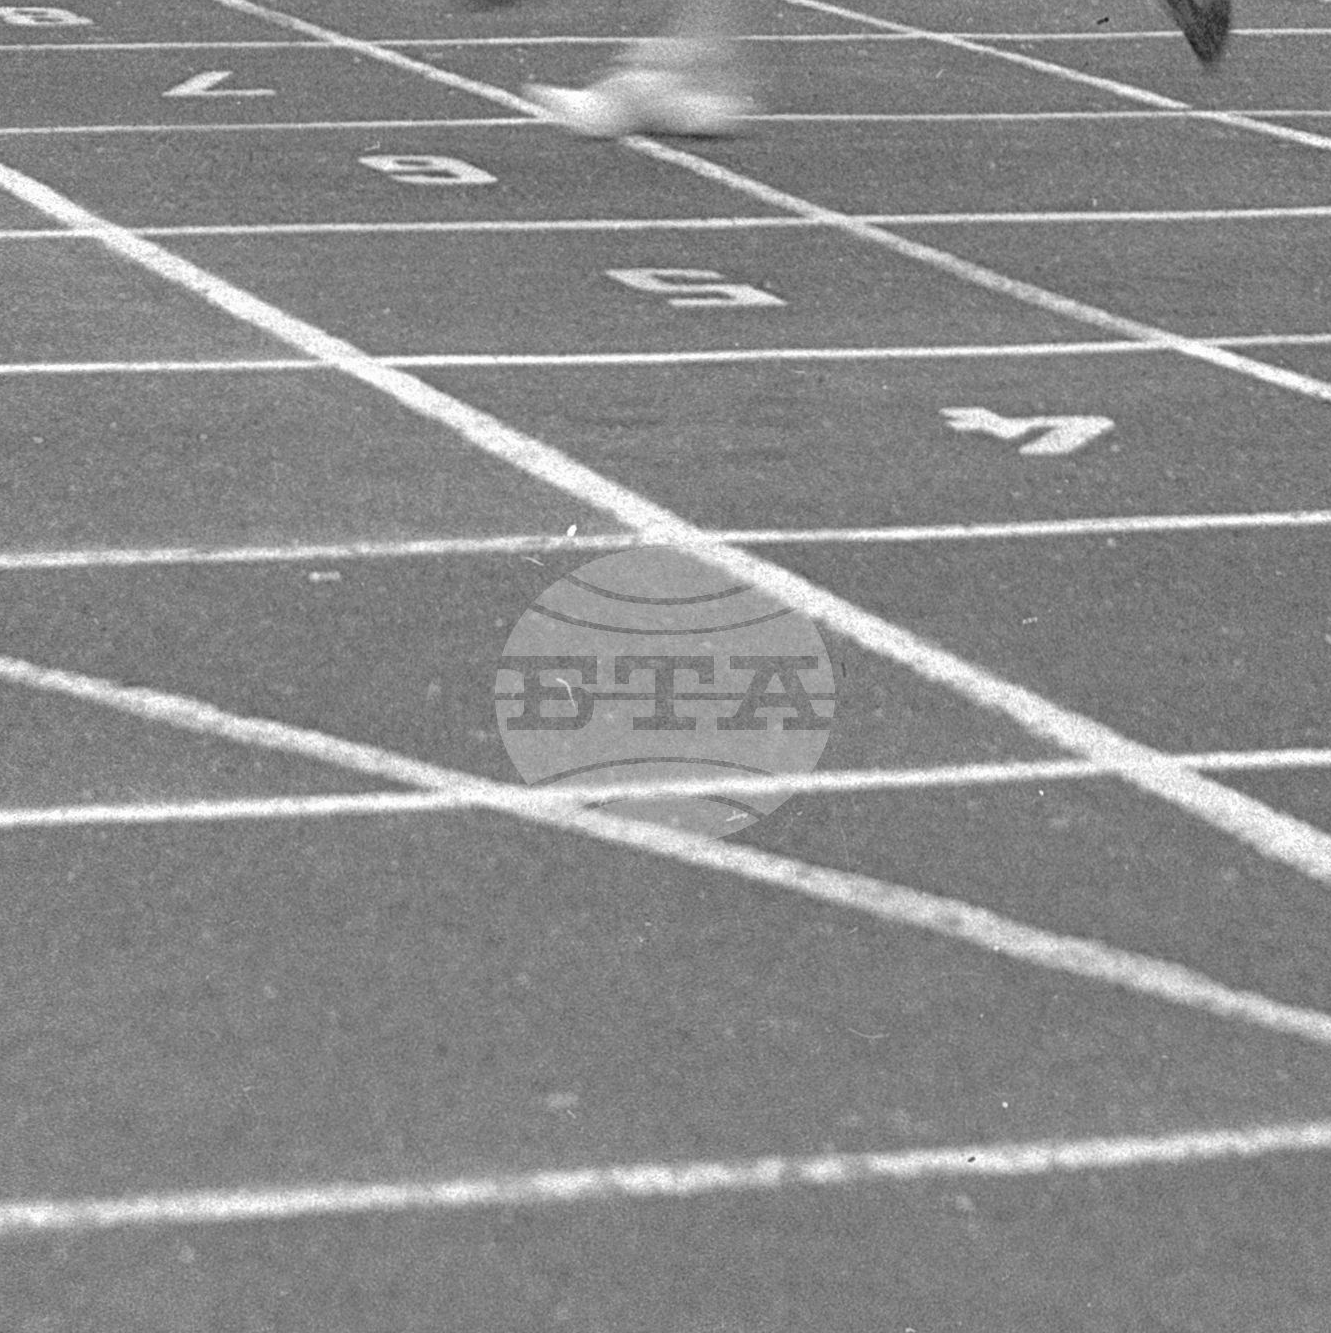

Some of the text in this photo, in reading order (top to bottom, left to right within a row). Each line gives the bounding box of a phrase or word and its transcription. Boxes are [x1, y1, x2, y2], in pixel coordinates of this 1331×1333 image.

[162, 71, 276, 97] 7
[358, 155, 498, 185] 6
[605, 268, 788, 307] 5
[939, 407, 1115, 456] 4
